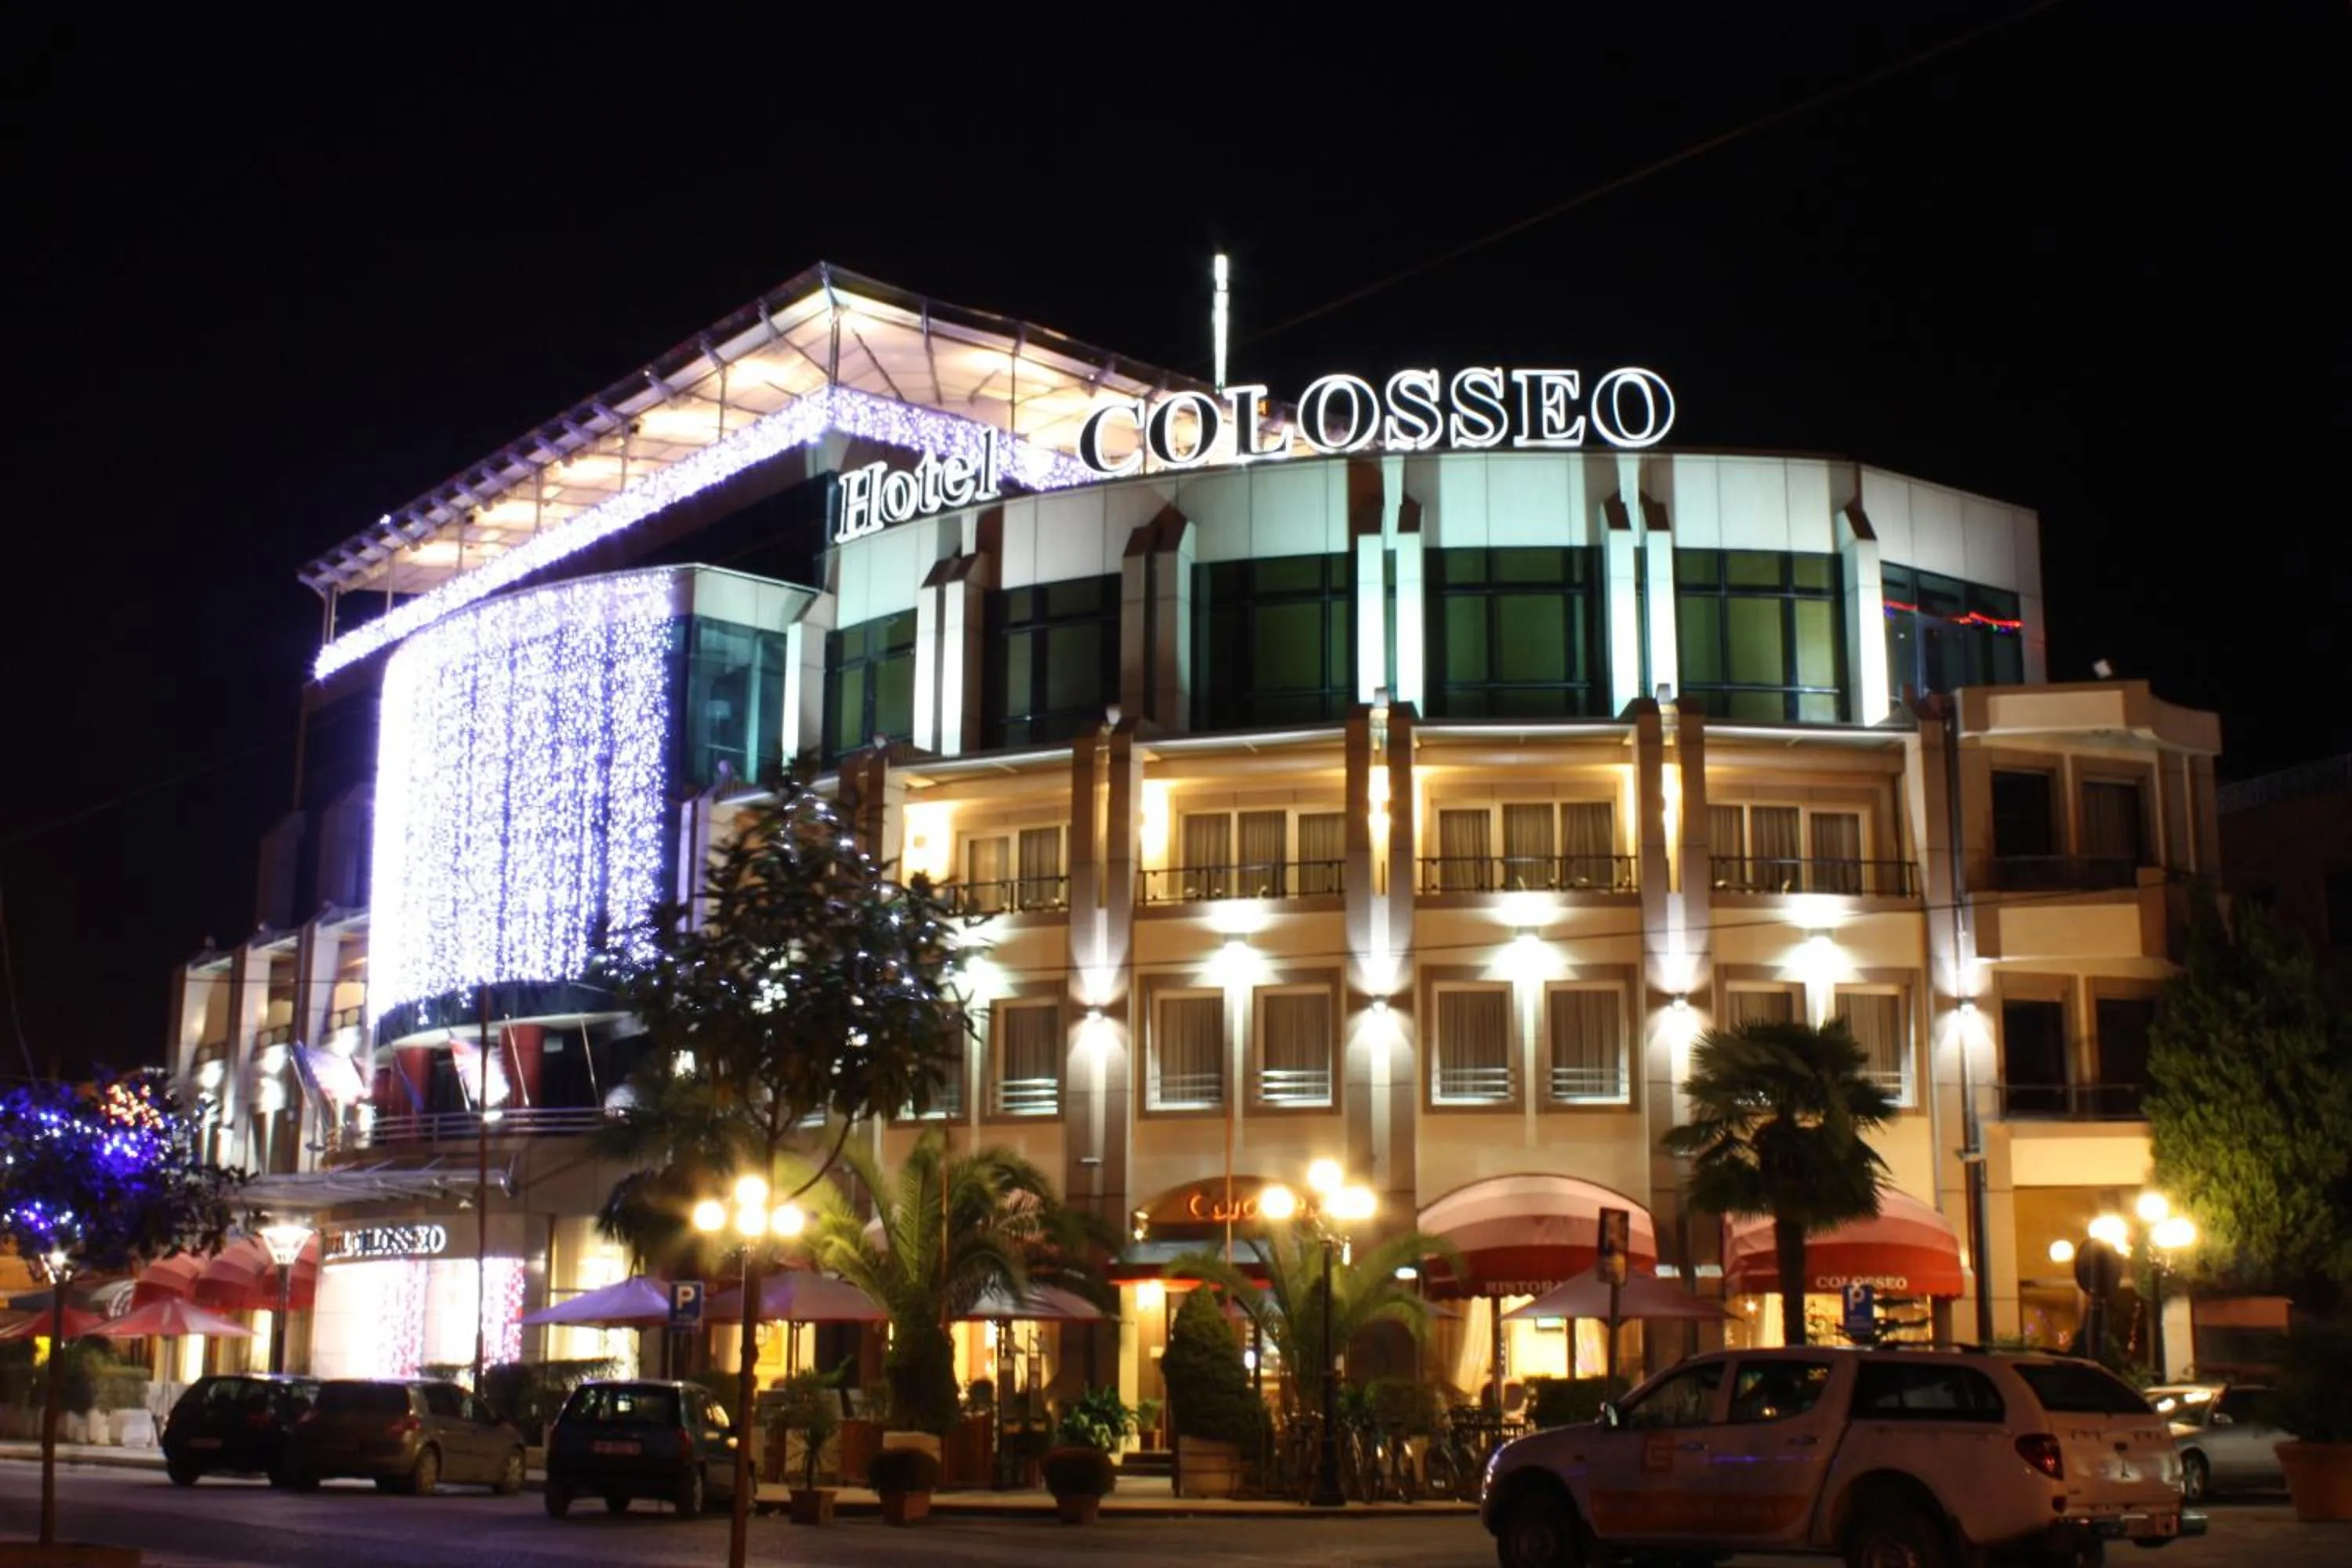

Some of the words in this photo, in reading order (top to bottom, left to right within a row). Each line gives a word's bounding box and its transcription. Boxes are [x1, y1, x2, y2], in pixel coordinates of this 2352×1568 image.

[835, 426, 1001, 543] Hotel
[1078, 367, 1675, 478] COLOSSEO
[677, 1286, 695, 1309] P
[1848, 1287, 1865, 1312] P
